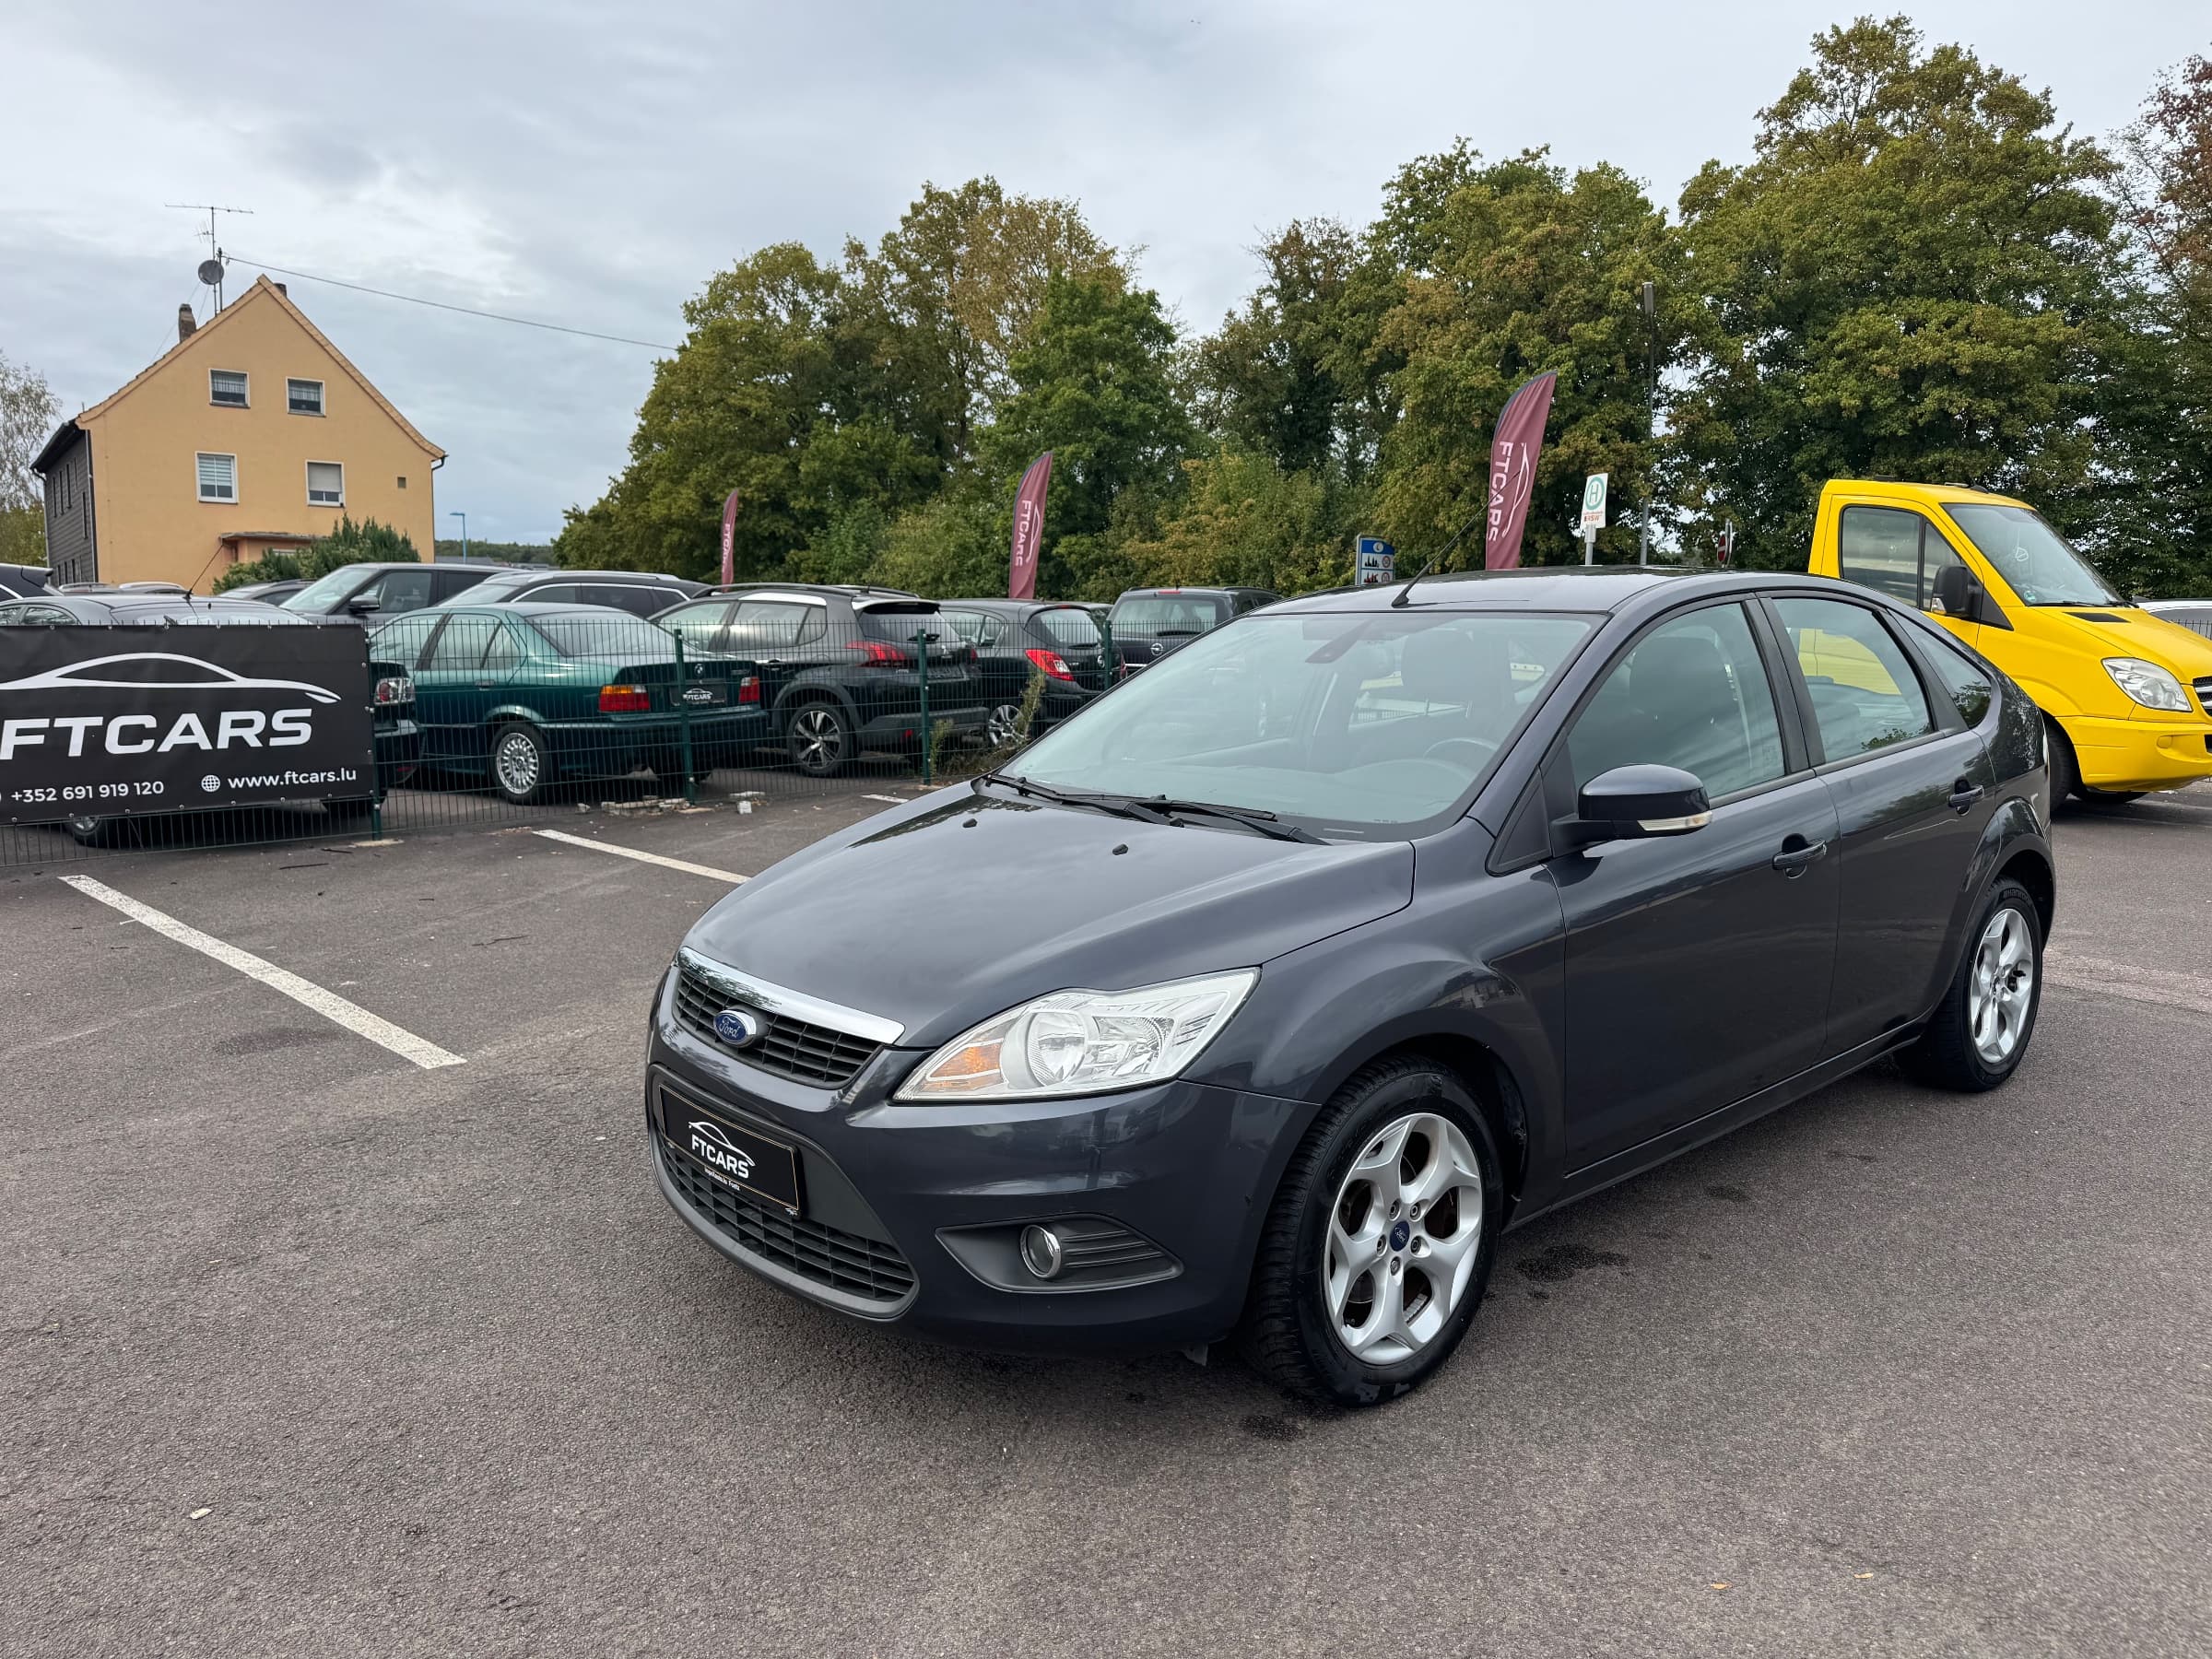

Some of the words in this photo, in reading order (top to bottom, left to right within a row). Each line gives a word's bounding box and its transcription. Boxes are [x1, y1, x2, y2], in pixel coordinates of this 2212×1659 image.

[1488, 441, 1513, 541] FTCARS
[0, 708, 312, 760] FTCARS
[11, 787, 57, 803] +352
[62, 785, 93, 800] 691
[99, 783, 129, 798] 919
[134, 781, 164, 795] 120
[228, 767, 357, 789] www.ftcars.lu
[719, 1016, 741, 1039] Ford
[691, 1134, 749, 1179] FTCARS
